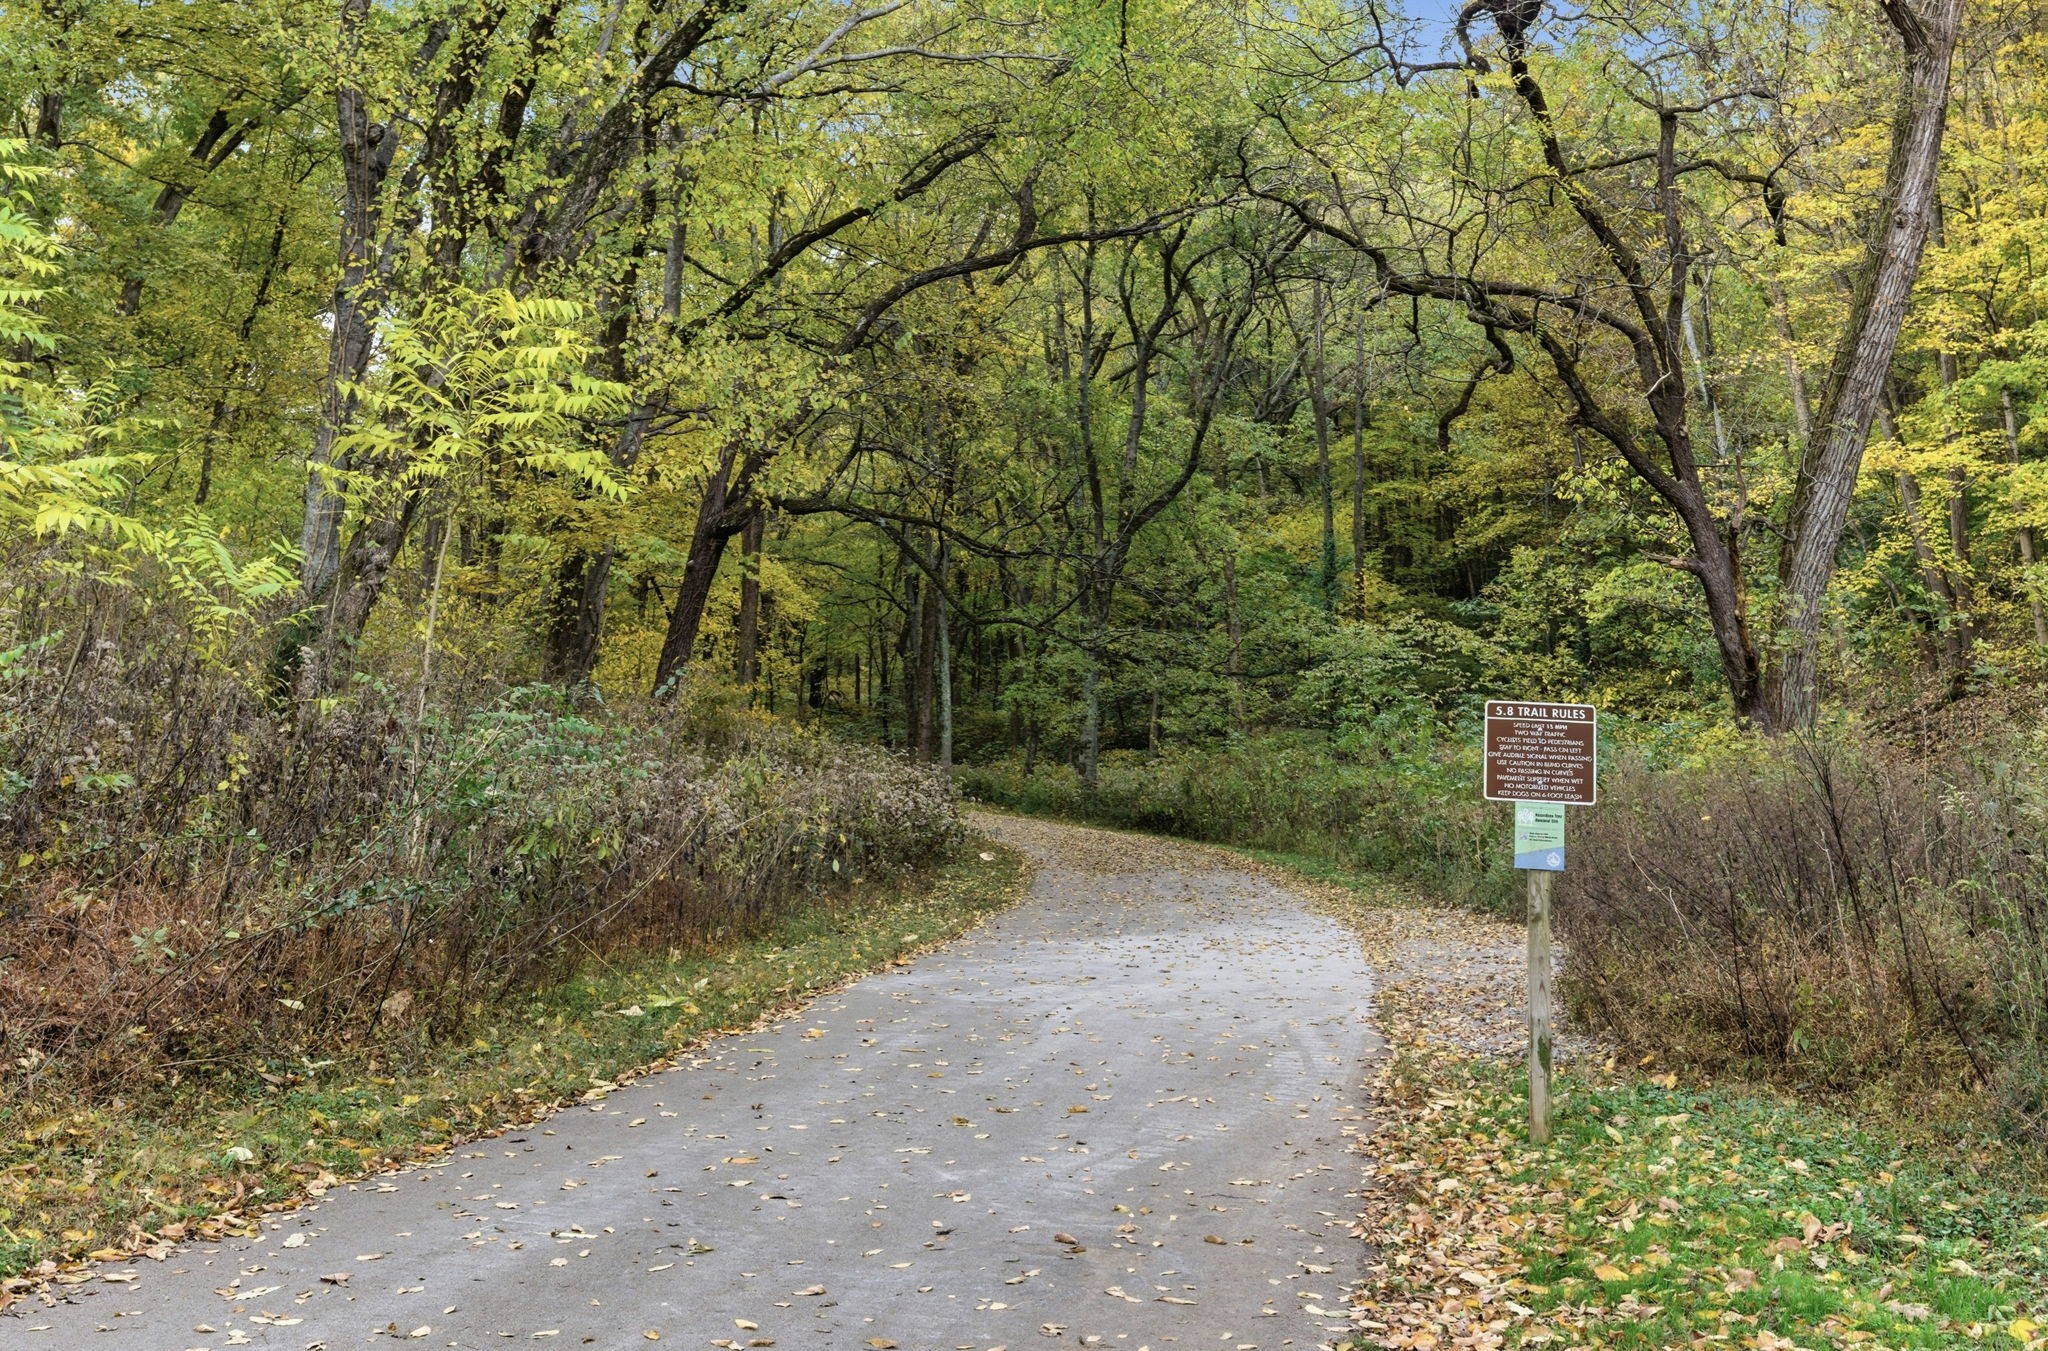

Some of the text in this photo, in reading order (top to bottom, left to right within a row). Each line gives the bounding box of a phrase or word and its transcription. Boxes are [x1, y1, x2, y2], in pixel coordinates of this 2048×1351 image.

[1496, 706, 1586, 719] 5.8 TRAIL RULES
